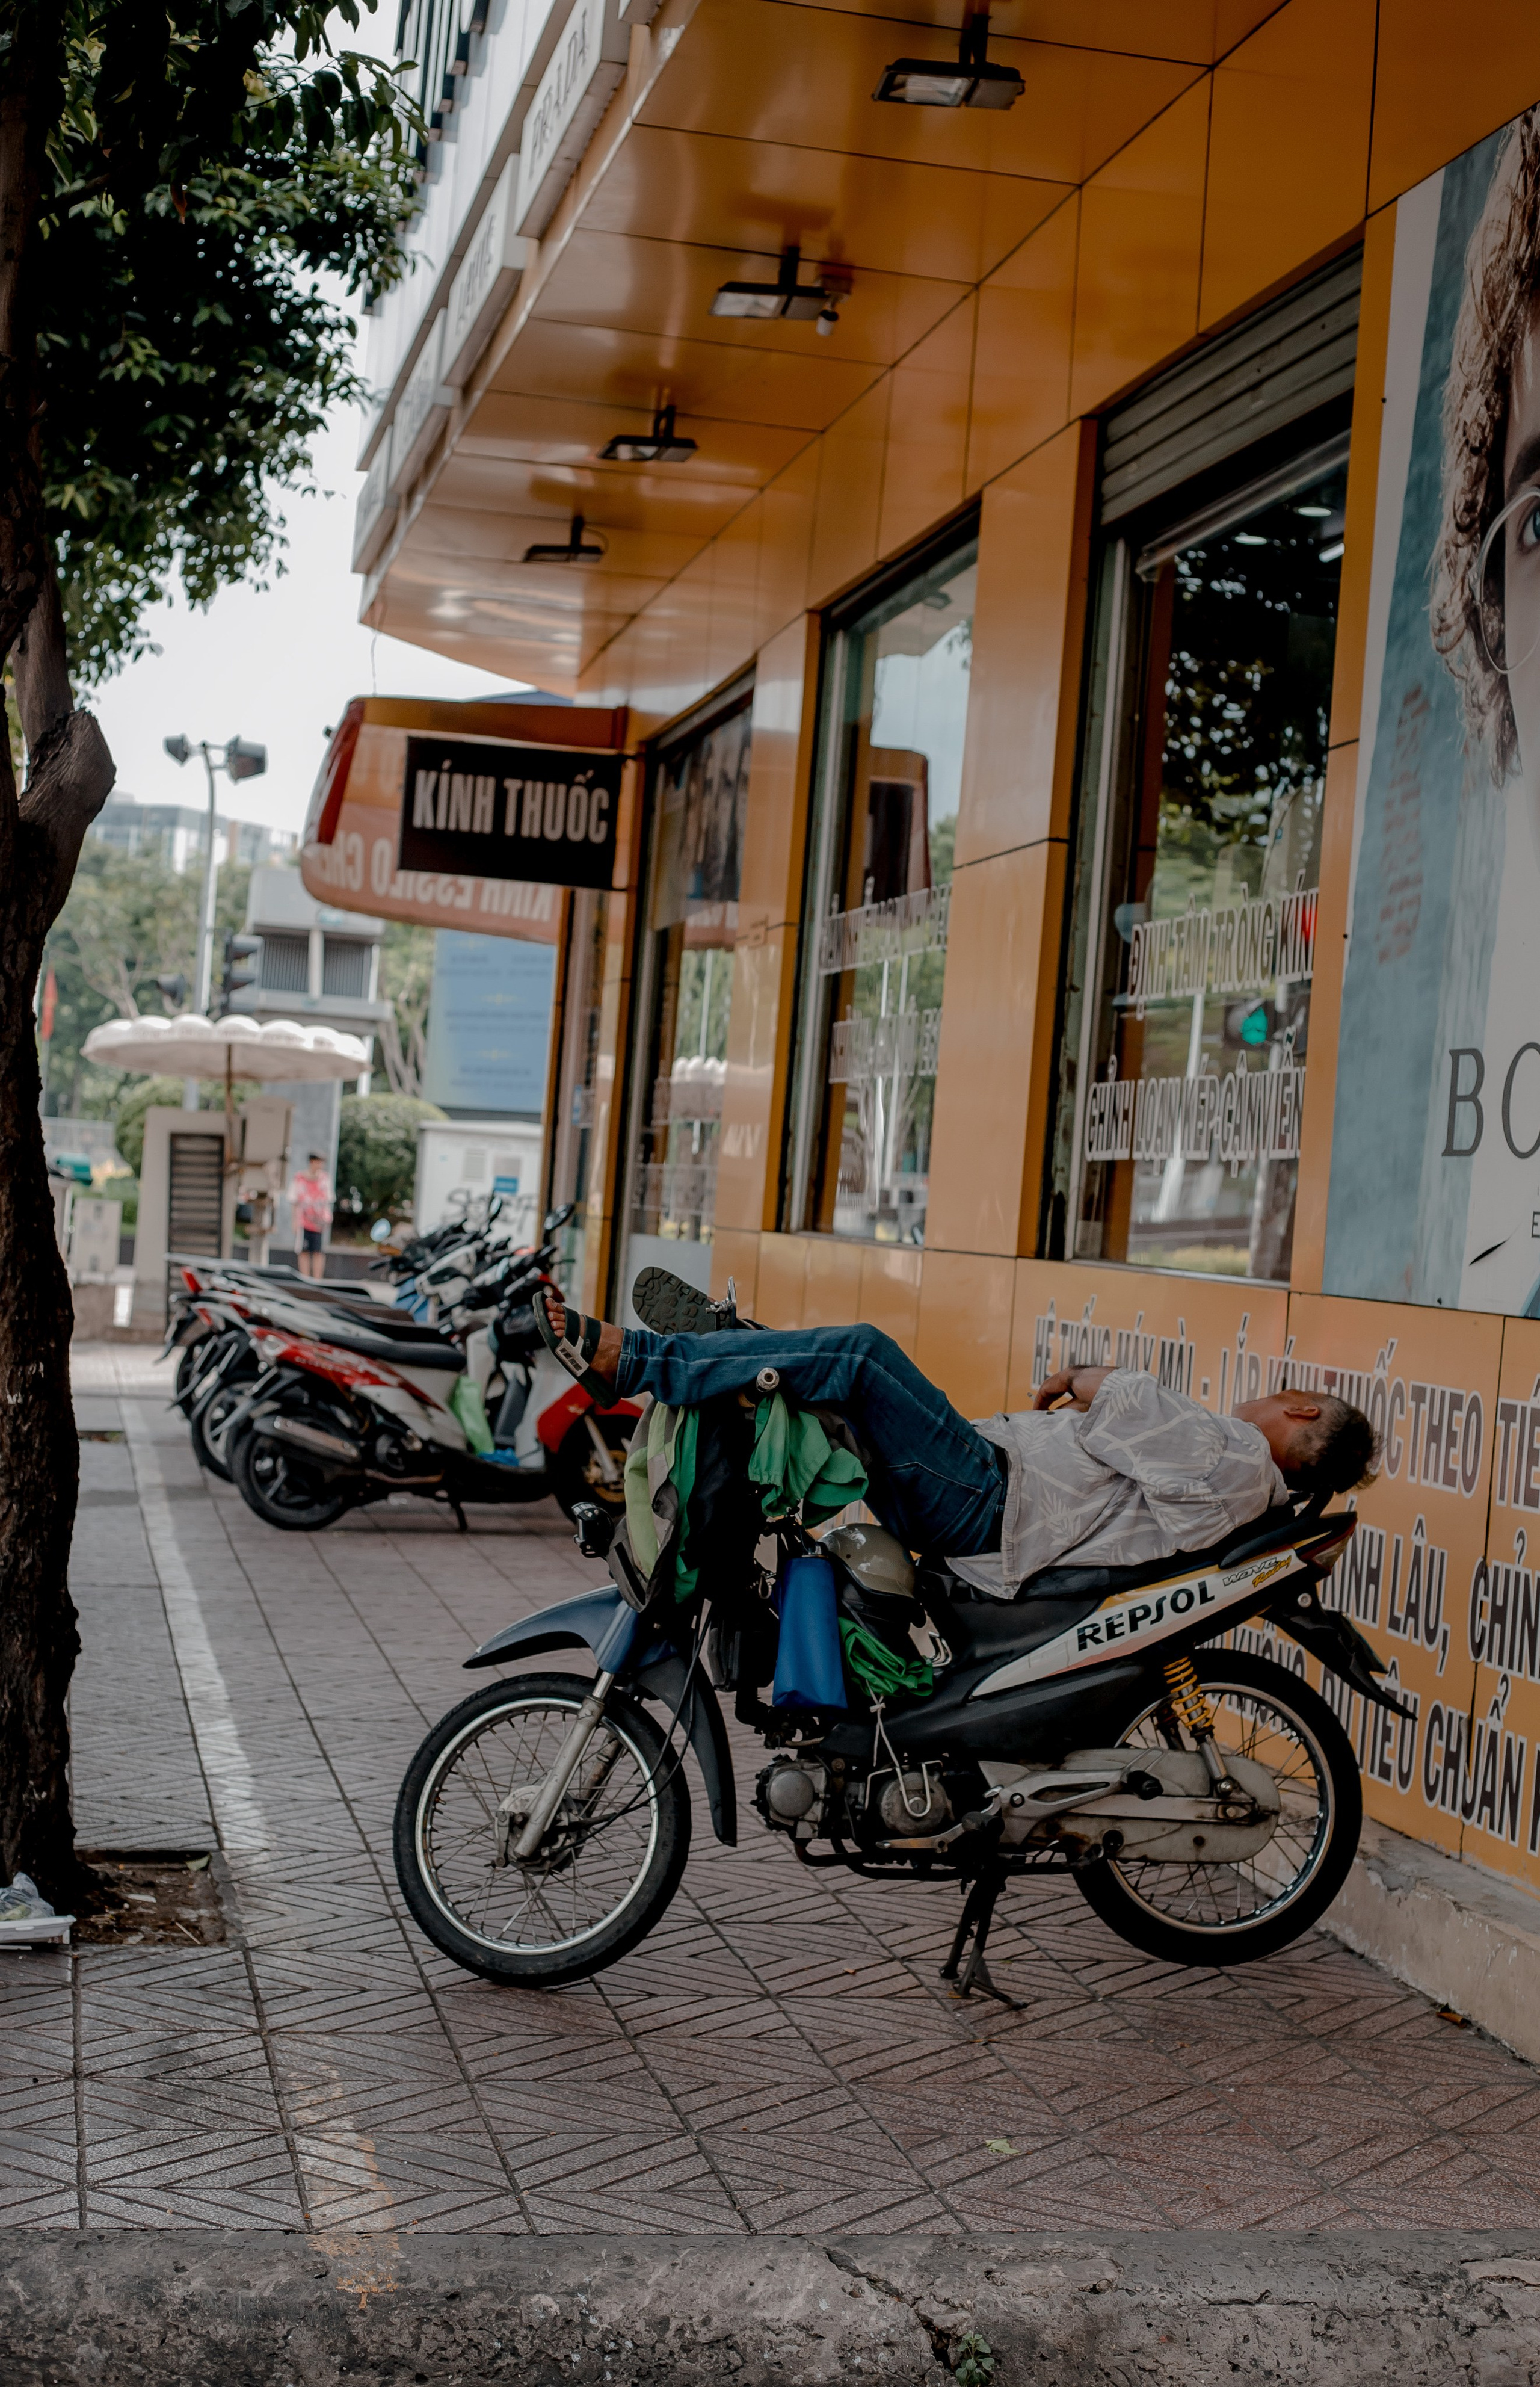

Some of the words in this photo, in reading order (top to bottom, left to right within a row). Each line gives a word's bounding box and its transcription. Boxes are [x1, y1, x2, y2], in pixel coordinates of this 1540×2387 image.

[413, 759, 496, 835] KÍNH
[503, 769, 609, 844] THUỐC
[1408, 1379, 1484, 1499] THEO
[1077, 1579, 1216, 1652] REPSOL
[1386, 1513, 1451, 1678] LÂU,
[1422, 1673, 1527, 1848] CHUẨN
